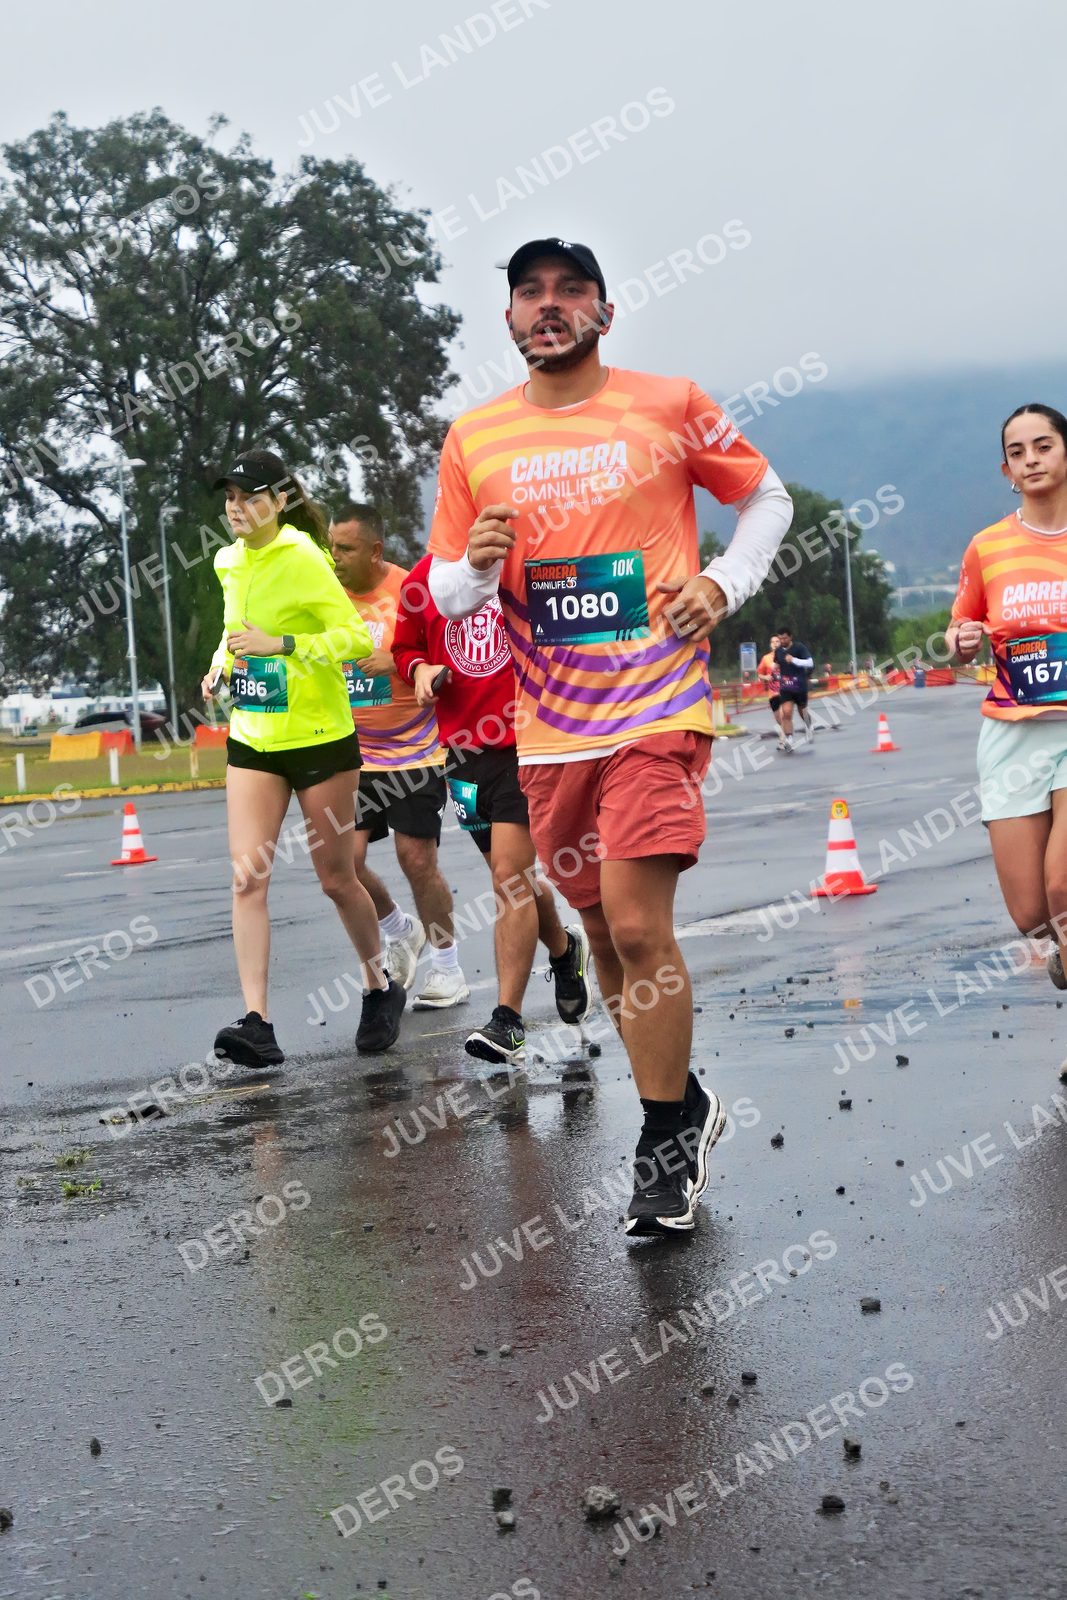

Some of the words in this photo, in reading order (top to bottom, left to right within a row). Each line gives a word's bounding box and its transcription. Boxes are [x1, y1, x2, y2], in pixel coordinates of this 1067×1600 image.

[511, 440, 627, 483] CARRERA
[512, 474, 602, 504] OMNILIFE
[531, 564, 577, 580] CARRERA
[612, 558, 635, 577] 10K
[531, 580, 566, 590] OMNILIFE
[545, 592, 619, 620] 1080
[1001, 602, 1067, 622] OMNILIFE
[450, 624, 458, 644] CLUB
[1011, 640, 1047, 655] CARRERA
[264, 662, 280, 673] 10K
[451, 645, 481, 671] DEPORTIVO
[1011, 653, 1038, 663] OMNILIFE
[1023, 661, 1067, 685] 167
[235, 678, 267, 697] 1386
